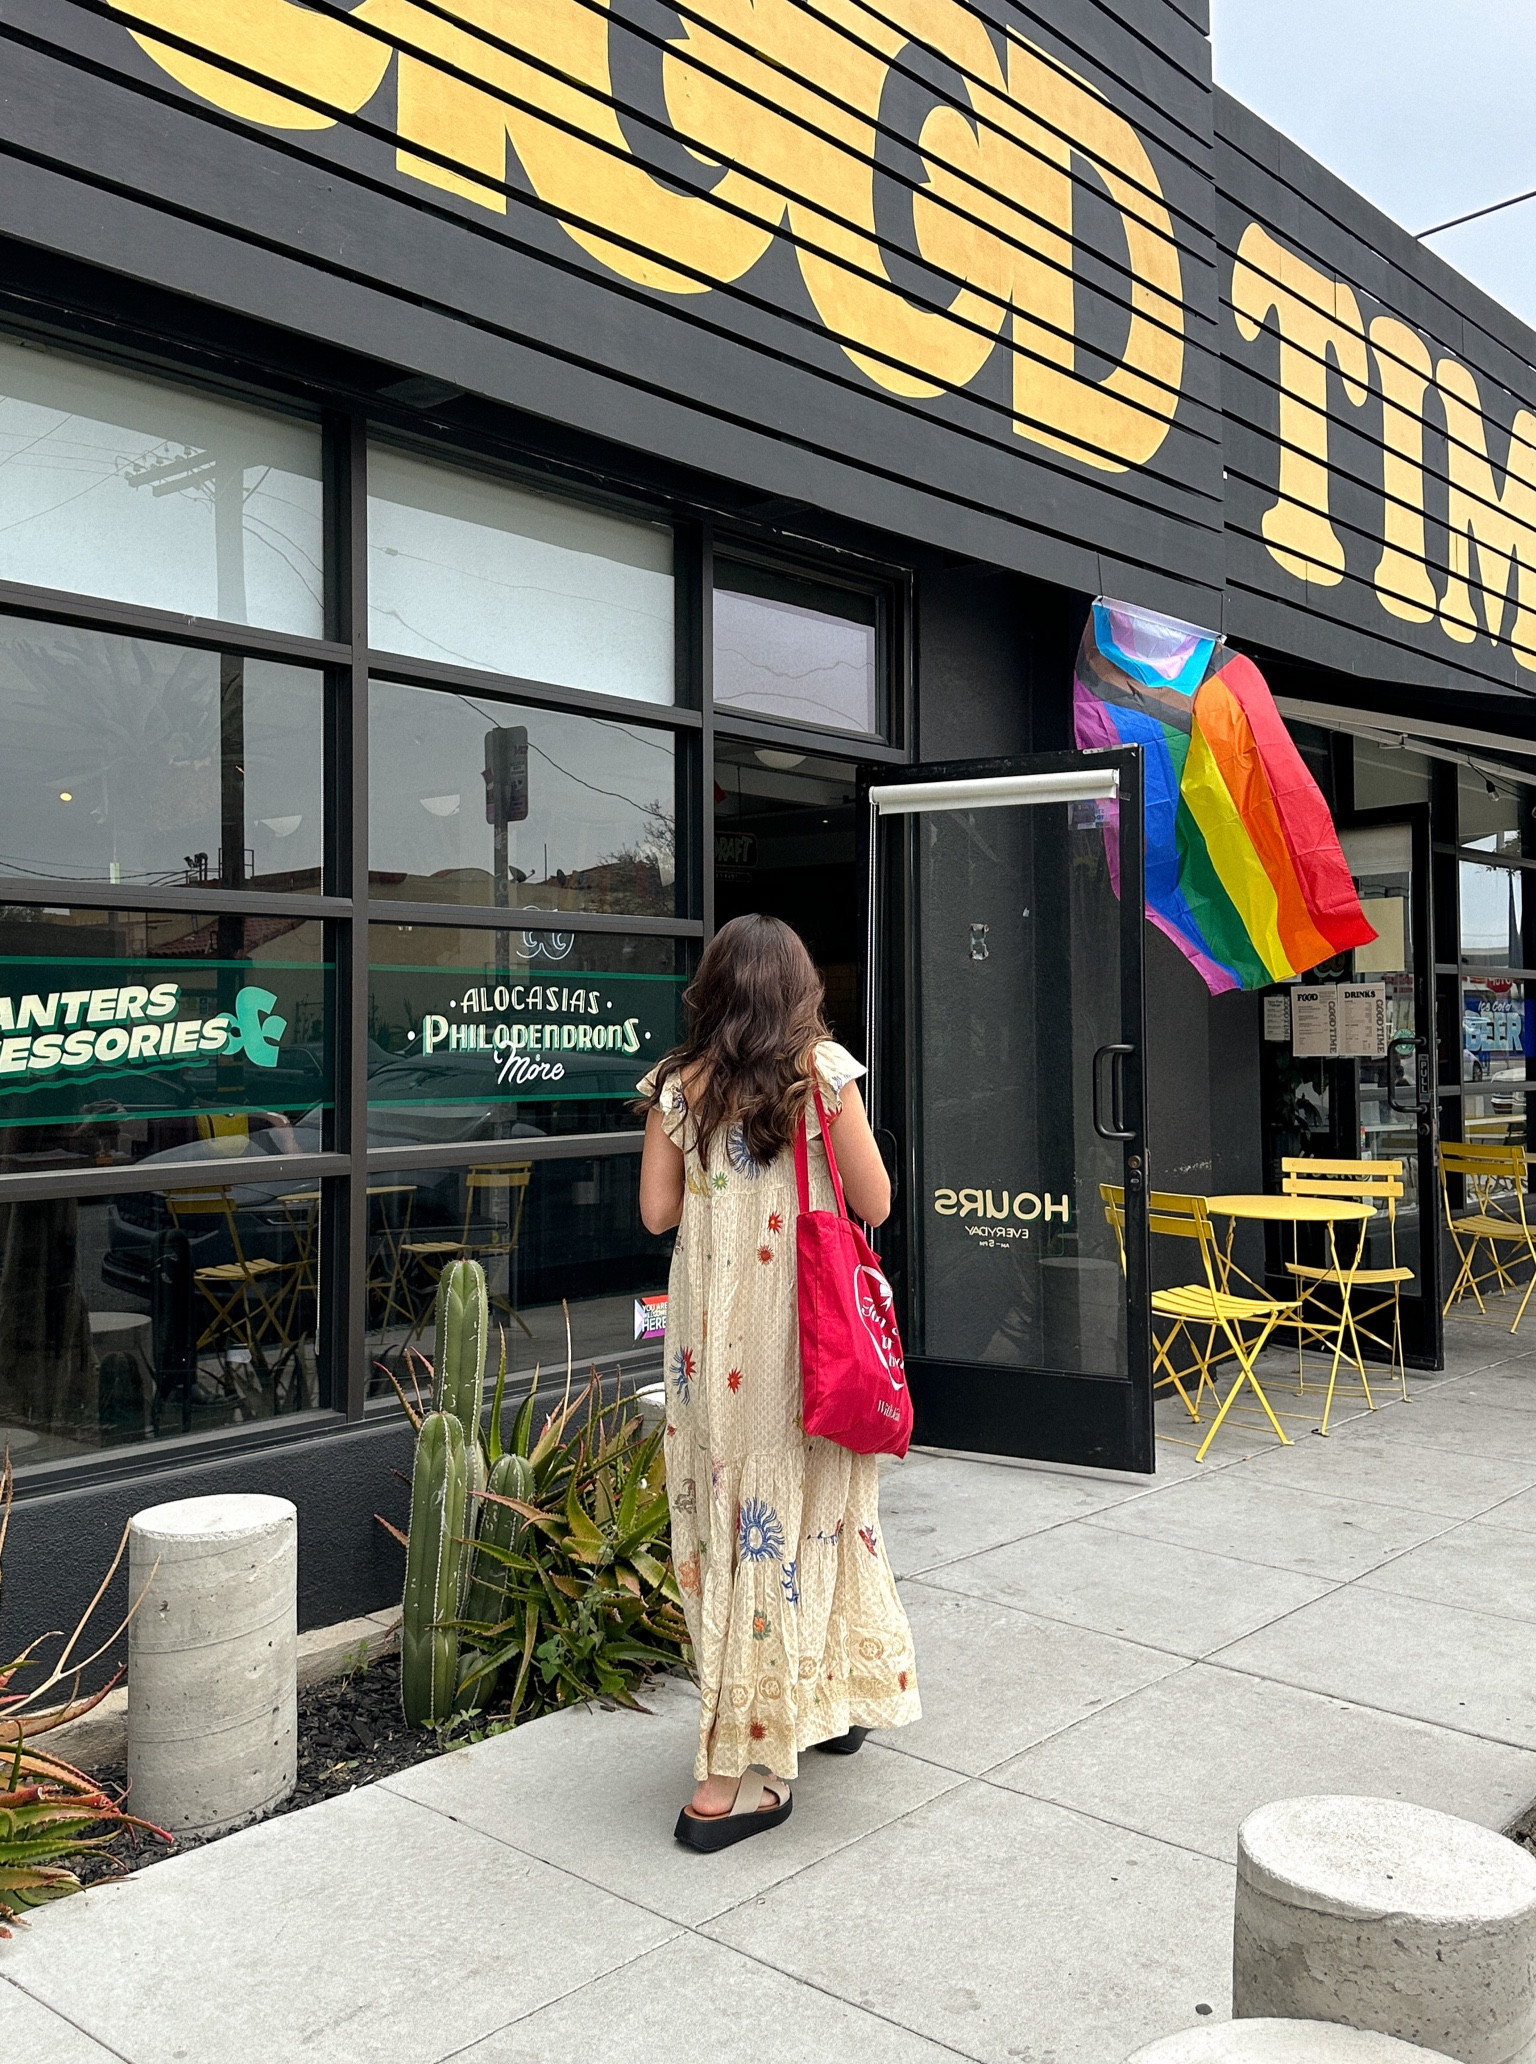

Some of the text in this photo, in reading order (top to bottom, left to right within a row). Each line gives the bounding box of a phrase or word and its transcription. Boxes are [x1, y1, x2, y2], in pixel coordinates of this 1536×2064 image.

[460, 986, 600, 1014] ALOCASIAS
[1344, 991, 1376, 999] DRINKS
[1464, 1009, 1523, 1052] BEER
[493, 1041, 565, 1085] More
[1420, 1061, 1428, 1093] PULL
[642, 1316, 667, 1332] HERE
